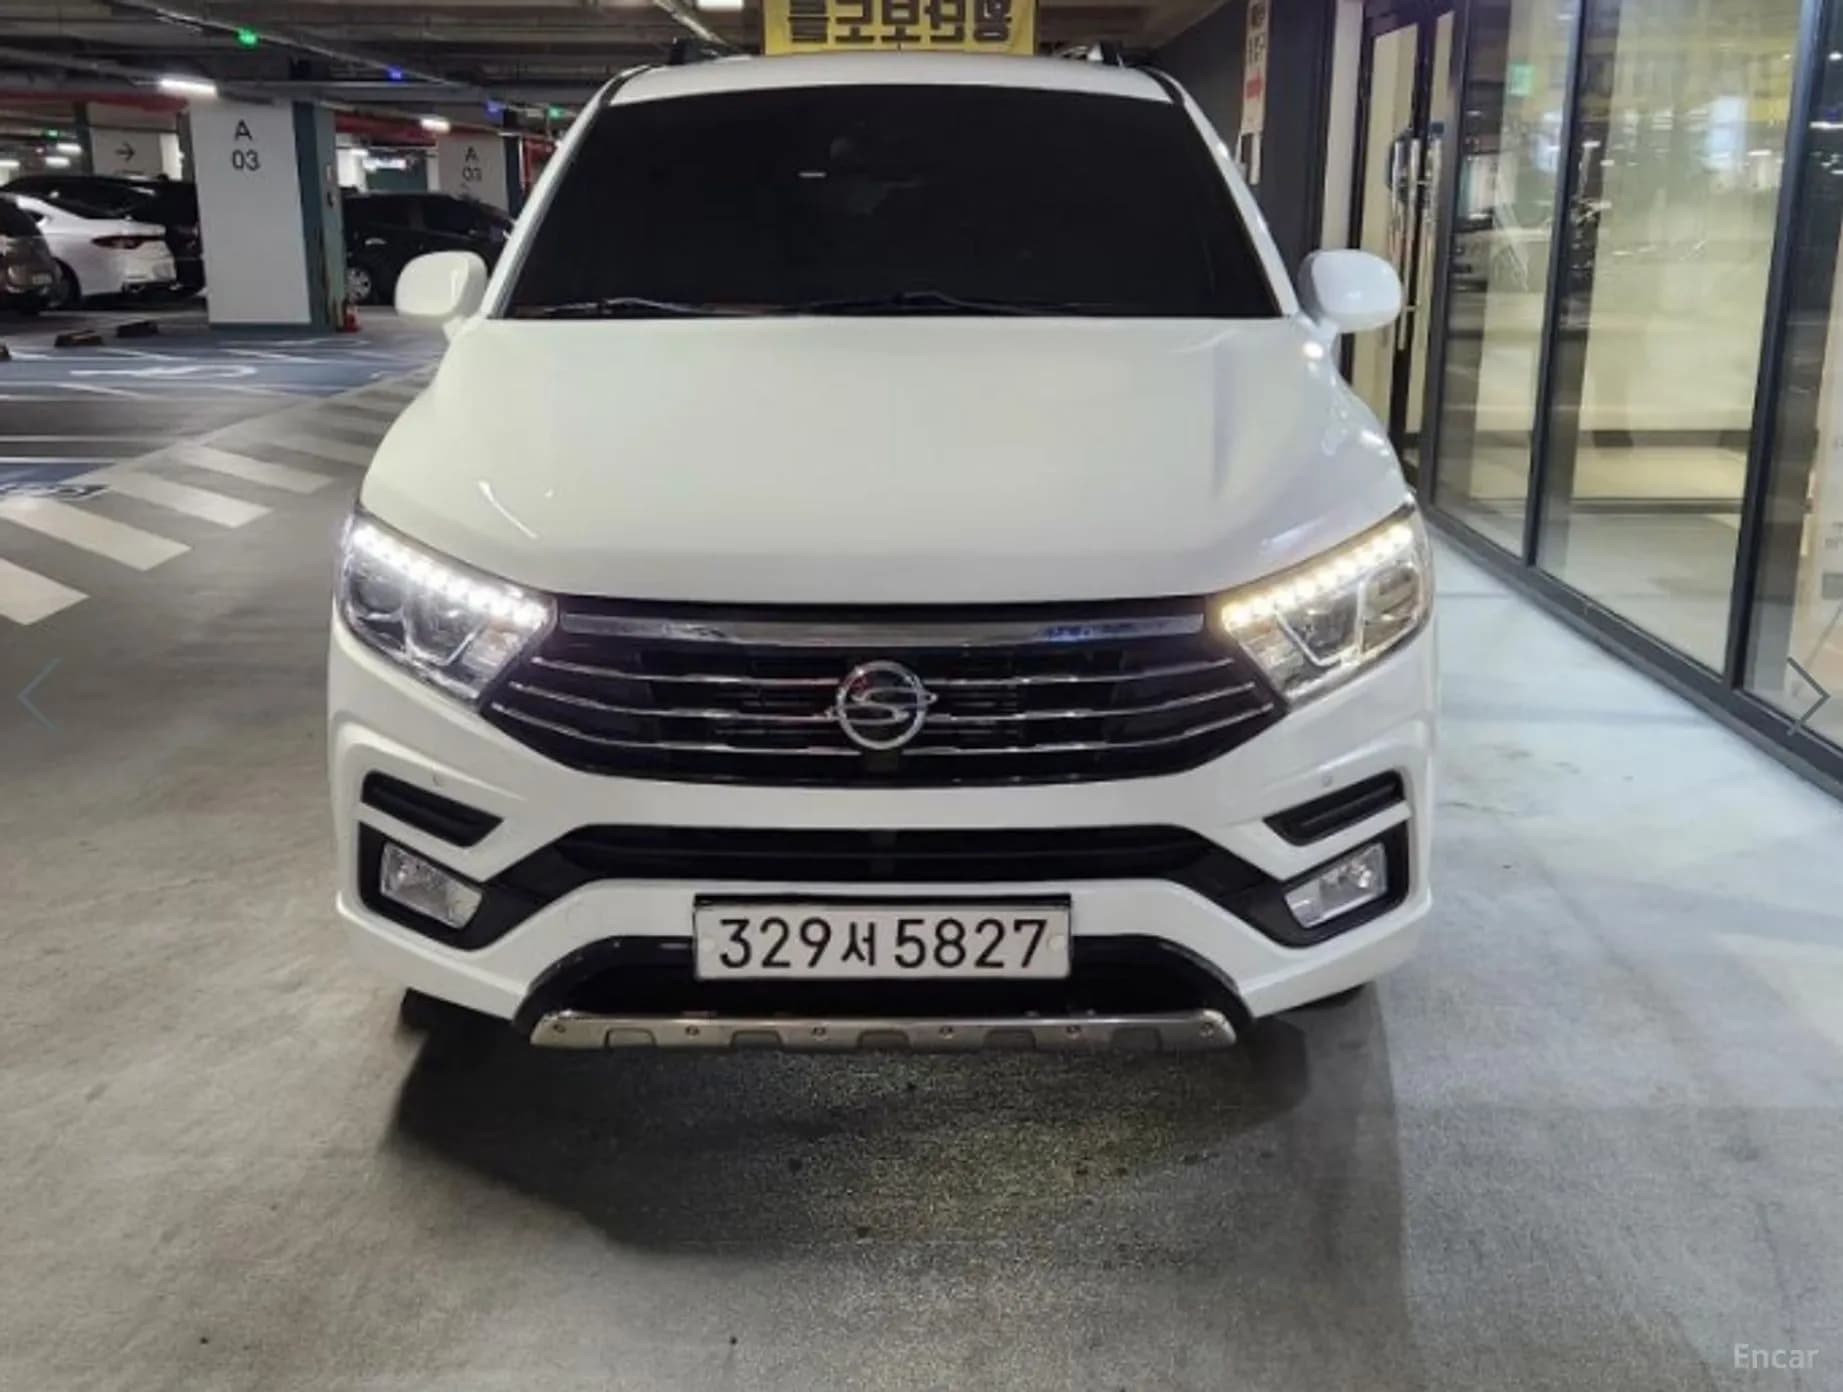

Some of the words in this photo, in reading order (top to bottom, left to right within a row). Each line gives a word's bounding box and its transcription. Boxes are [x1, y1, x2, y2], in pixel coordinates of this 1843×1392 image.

[234, 119, 253, 141] A
[232, 149, 261, 171] 03
[464, 145, 479, 162] A
